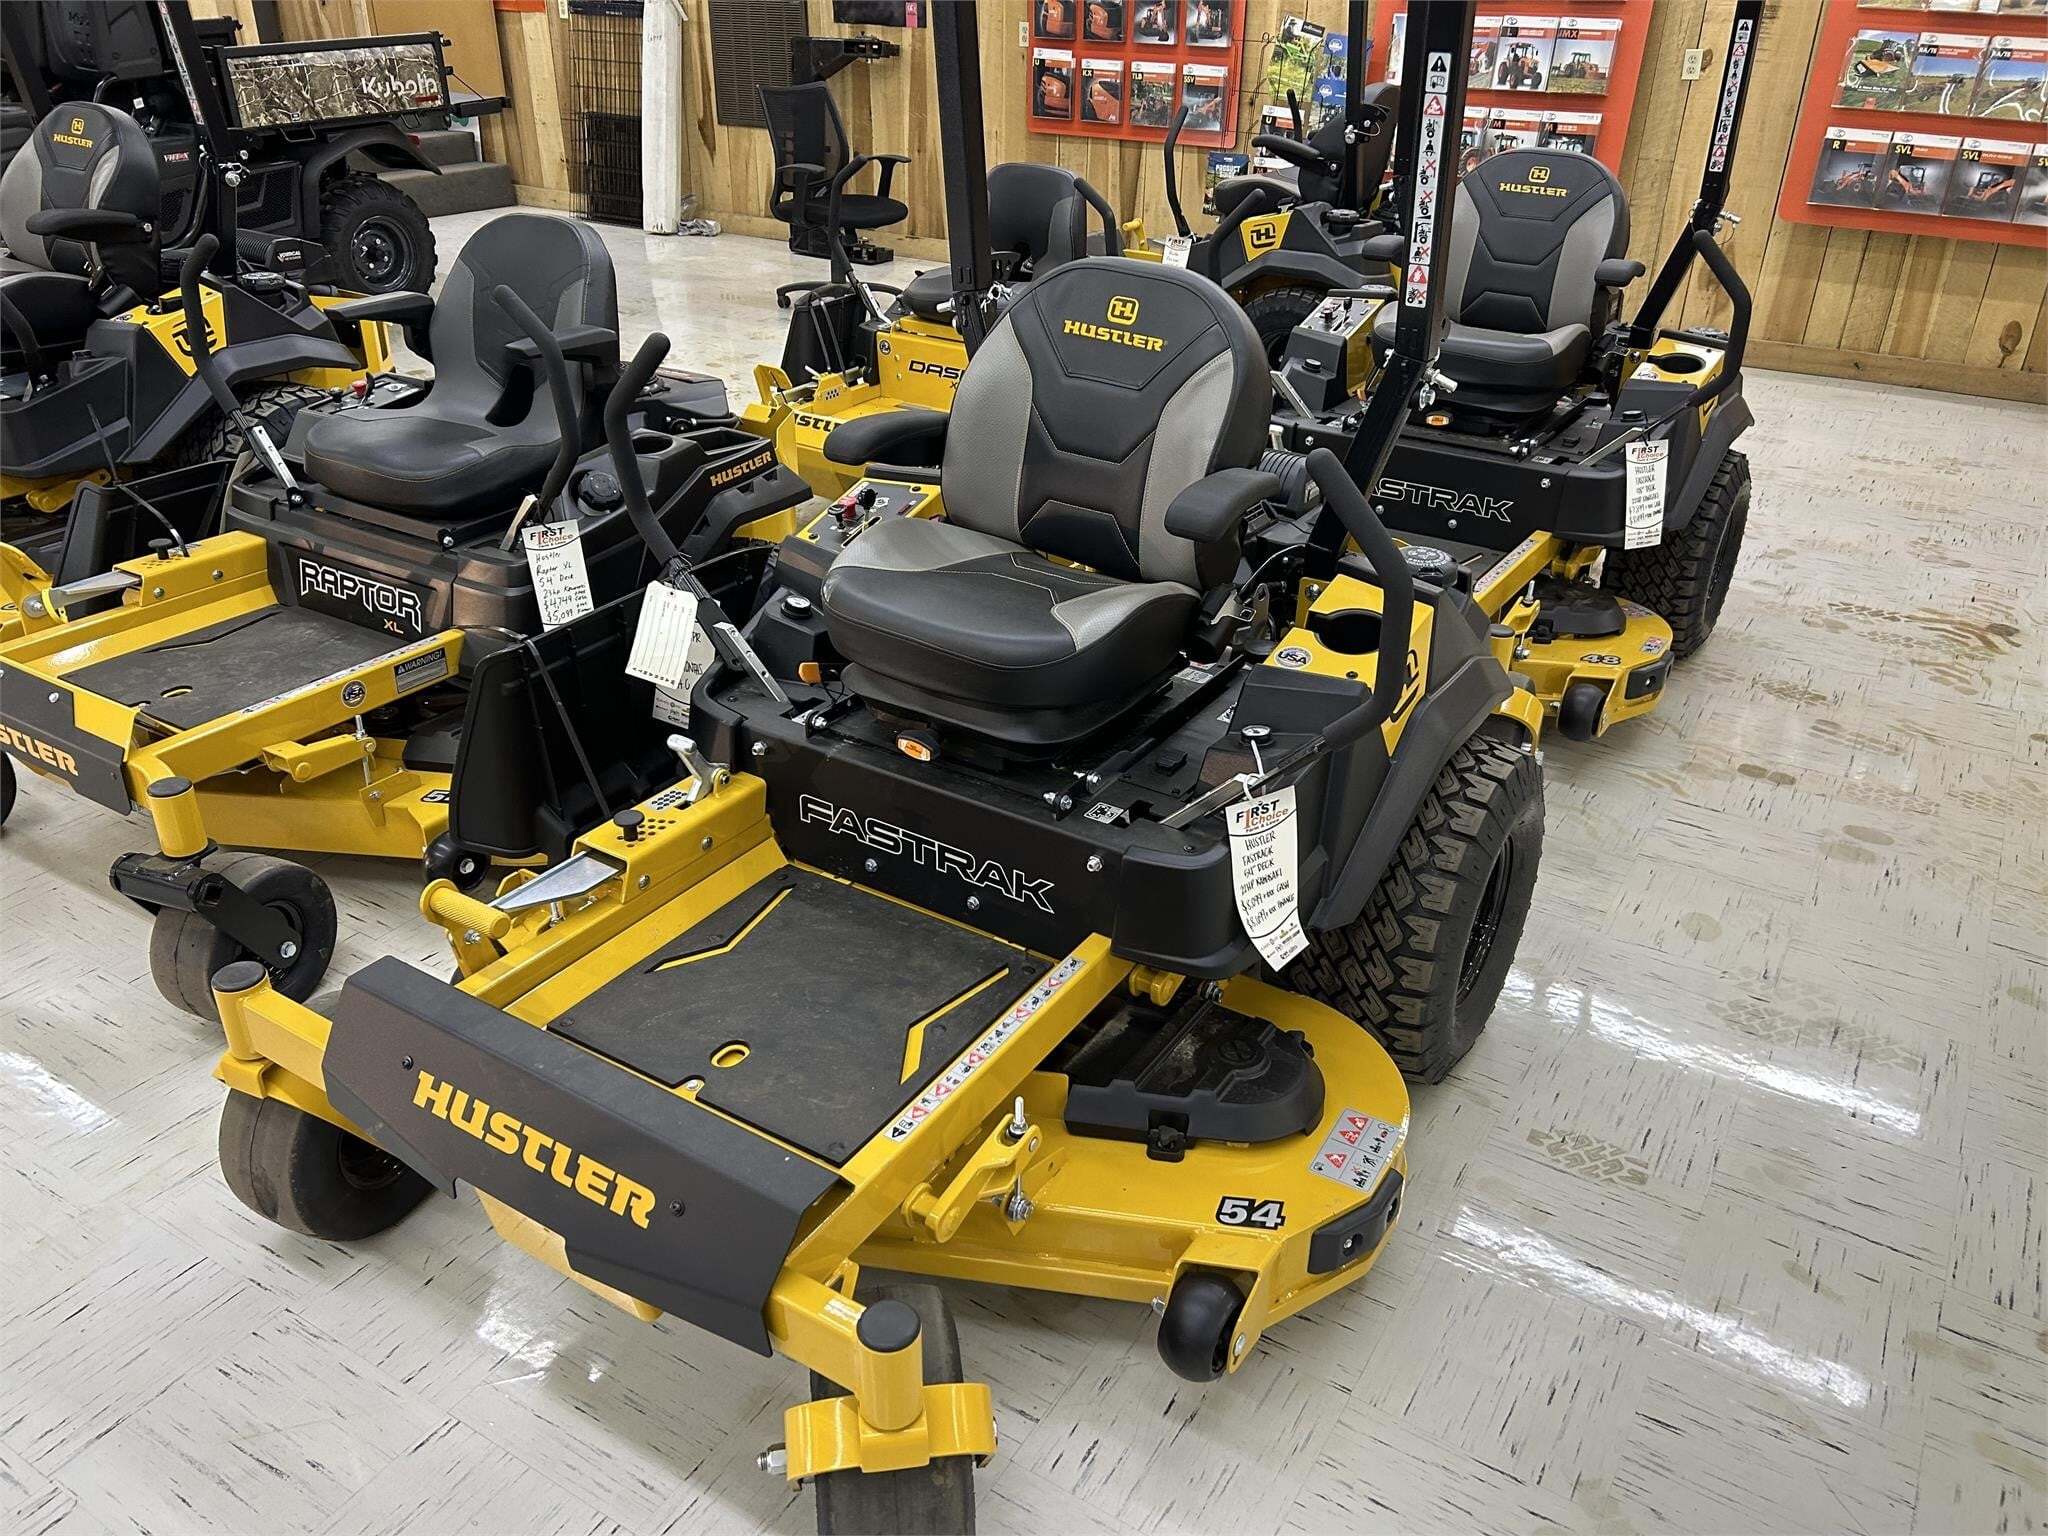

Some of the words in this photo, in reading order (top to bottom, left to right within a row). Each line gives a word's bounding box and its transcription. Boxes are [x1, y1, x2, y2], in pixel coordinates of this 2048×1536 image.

[53, 133, 93, 148] HUSTLER
[1832, 140, 1840, 149] R
[1894, 144, 1912, 154] SVL
[1962, 150, 1980, 160] SVL
[2038, 158, 2048, 166] SV
[1499, 182, 1568, 197] HUSTLER
[1064, 320, 1164, 352] HUSTLER
[908, 360, 966, 381] DAS
[710, 450, 772, 487] HUSTLER
[1371, 477, 1514, 523] STRAK
[542, 533, 574, 544] Choice
[300, 558, 422, 634] RAPTOR
[384, 618, 404, 634] XL
[404, 650, 443, 671] WARNING!
[1278, 650, 1307, 664] USA
[1582, 654, 1620, 665] 48
[684, 660, 702, 675] ONTHS
[0, 724, 79, 776] STLER
[422, 790, 450, 802] 5
[1251, 808, 1289, 826] Choice
[1244, 830, 1276, 851] HUSTLER
[799, 793, 1055, 914] FASTRAK
[1257, 858, 1275, 873] DECK
[411, 1069, 656, 1229] HUSTLER
[1218, 1198, 1282, 1228] 54
